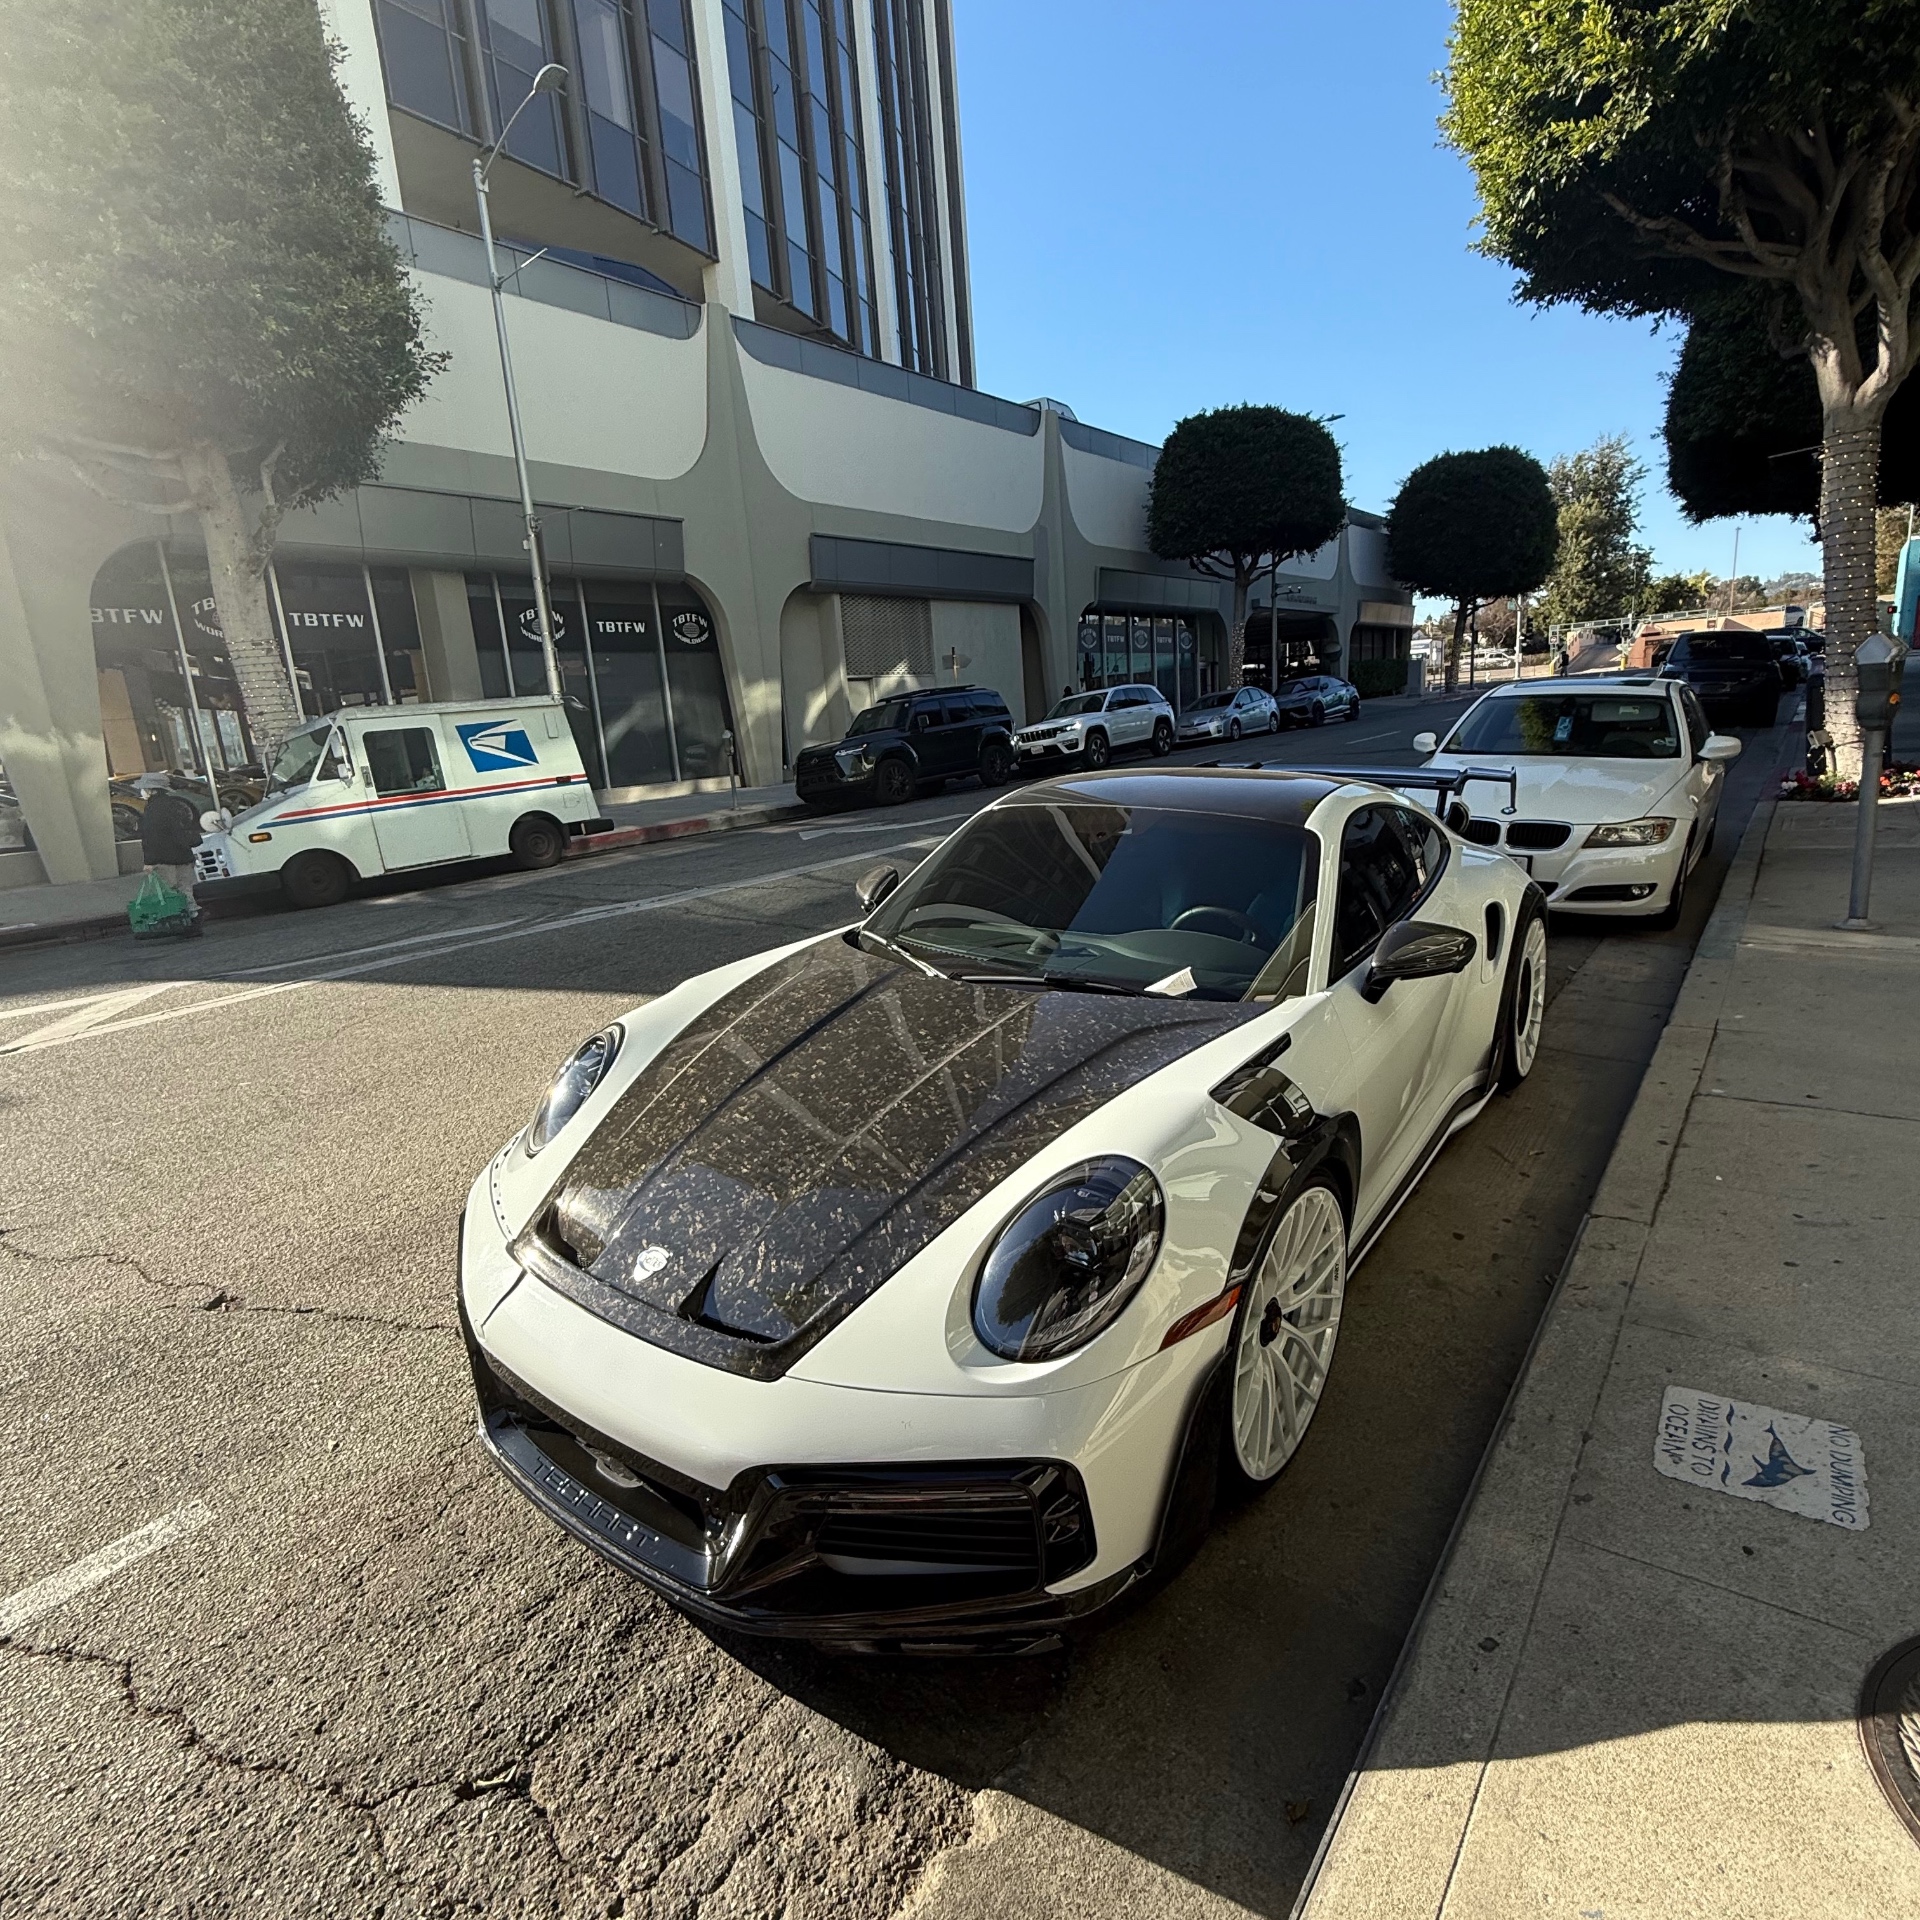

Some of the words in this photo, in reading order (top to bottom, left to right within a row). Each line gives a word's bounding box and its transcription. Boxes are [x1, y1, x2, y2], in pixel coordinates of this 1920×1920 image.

[91, 608, 163, 624] BTFW
[289, 612, 364, 628] TBTFW
[518, 608, 564, 624] TBW
[672, 613, 708, 628] TBTFW
[596, 621, 645, 633] TBTFW
[1107, 635, 1125, 643] TBTFW
[1661, 1404, 1690, 1457] OCEAN
[1692, 1399, 1721, 1453] DRAINS
[1828, 1424, 1851, 1447] NO
[1690, 1454, 1716, 1476] TO
[1829, 1450, 1857, 1524] DUMPING
[534, 1455, 660, 1547] TECHART
